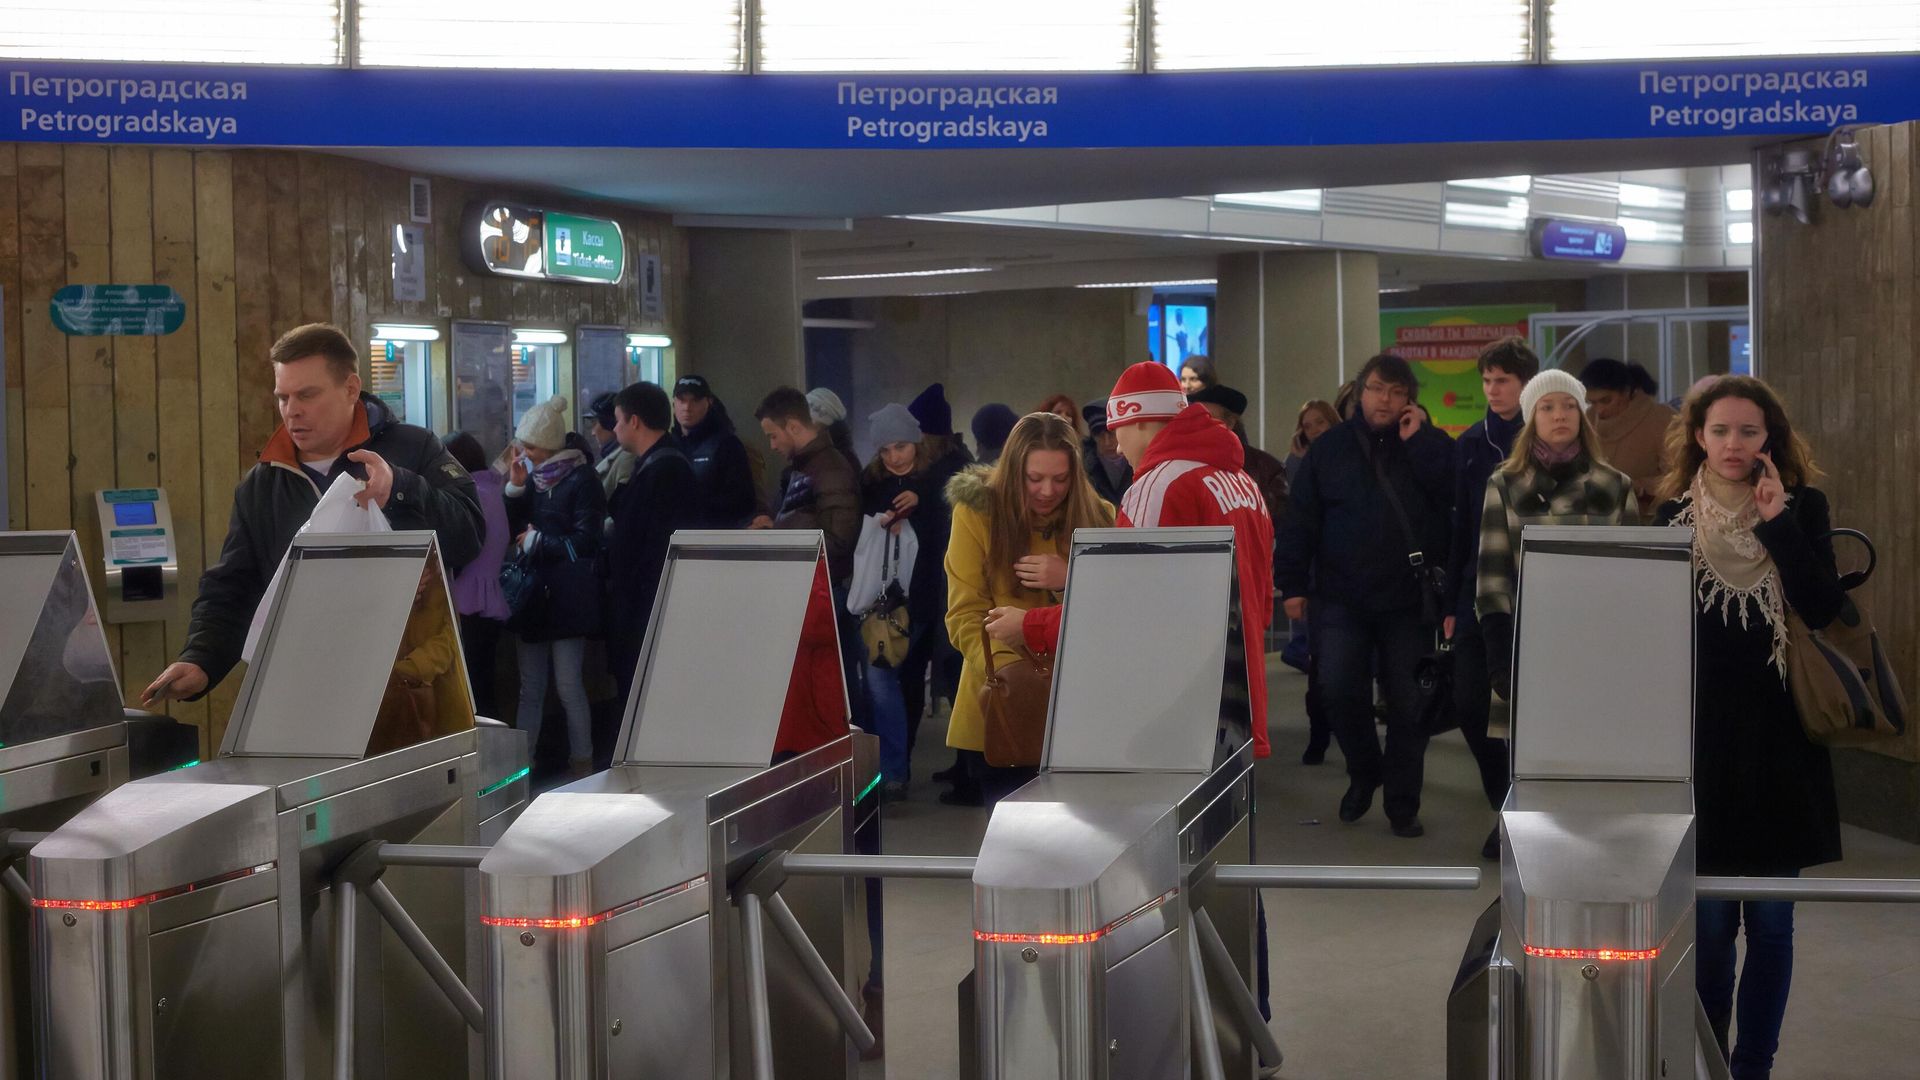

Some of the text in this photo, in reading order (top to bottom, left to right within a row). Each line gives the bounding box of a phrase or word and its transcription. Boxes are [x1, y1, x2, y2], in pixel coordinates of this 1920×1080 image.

[9, 71, 247, 104] Петроградская
[837, 81, 1058, 111] Петроградская
[1640, 69, 1868, 97] Петроградская
[21, 108, 237, 139] Petrogradskaya
[1650, 100, 1857, 129] Petrogradskaya
[847, 115, 1048, 143] Petrogradskaya
[582, 230, 604, 247] Кассы
[1402, 328, 1444, 341] СКОЛЬКО
[1447, 327, 1461, 340] ТЫ
